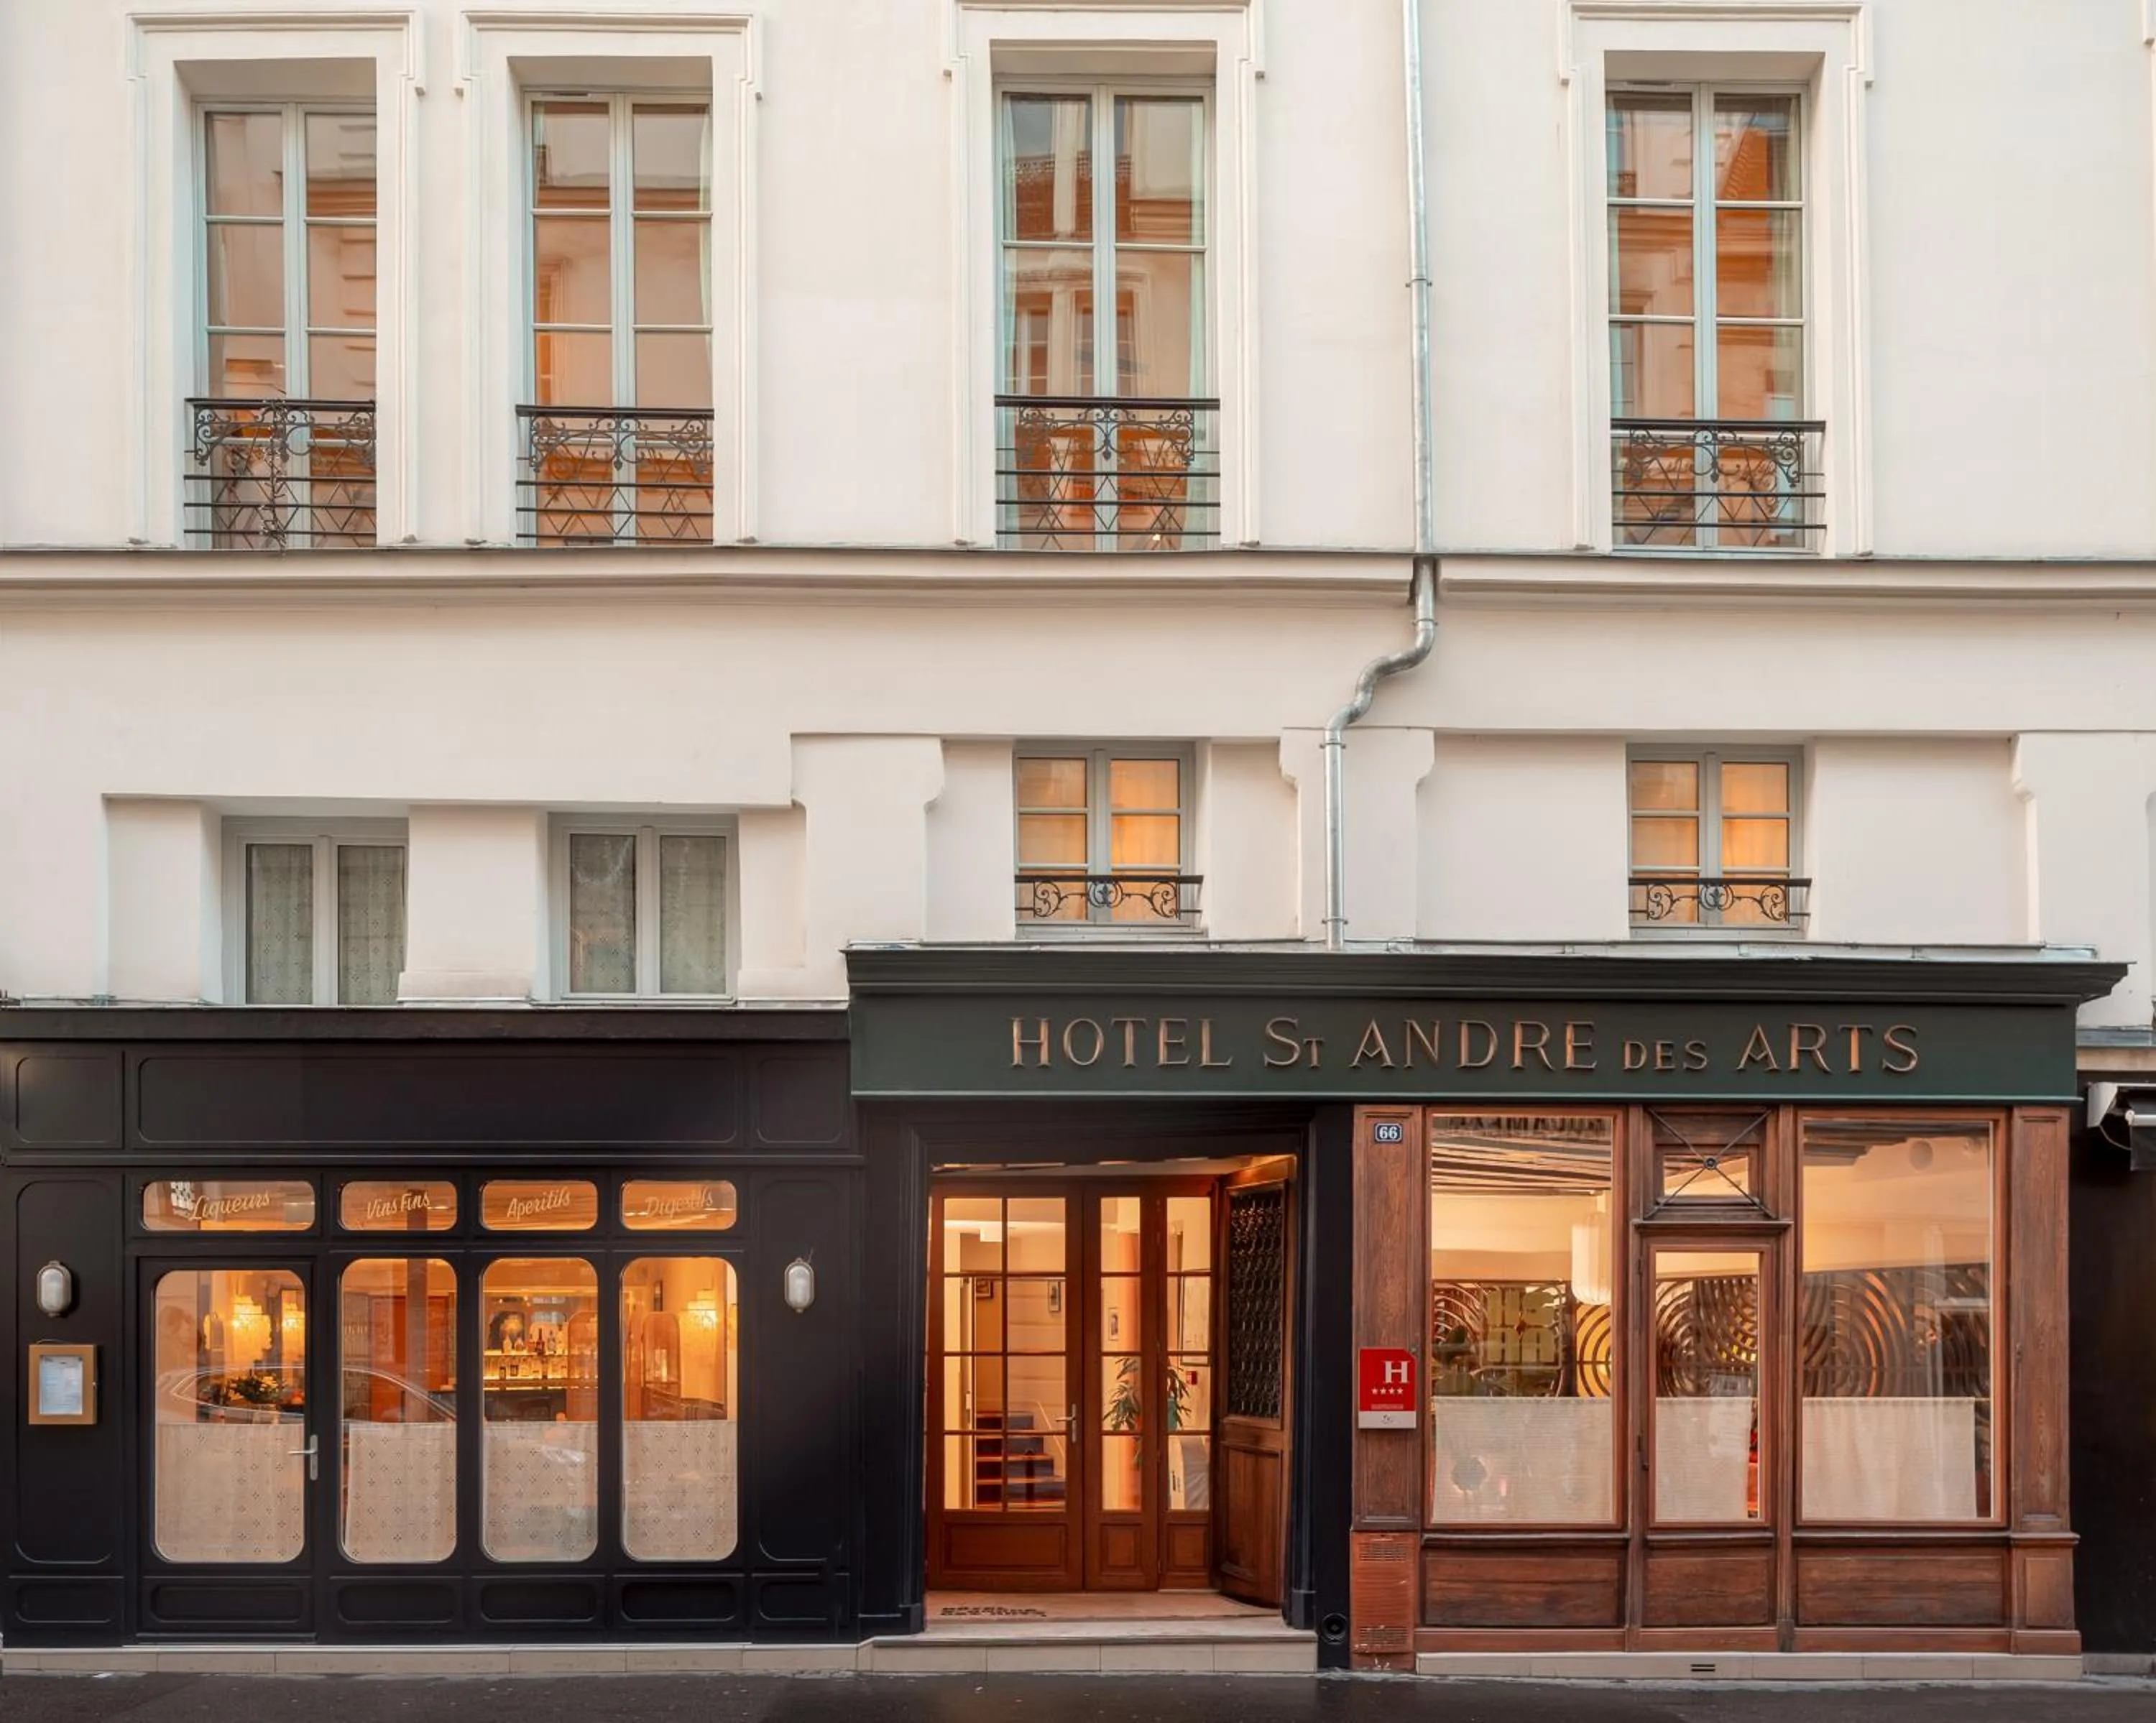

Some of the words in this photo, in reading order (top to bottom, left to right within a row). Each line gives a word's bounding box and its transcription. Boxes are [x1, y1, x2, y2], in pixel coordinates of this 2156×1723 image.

[1010, 1017, 1233, 1068] HOTEL
[1348, 1017, 1598, 1071] ANDRE
[1622, 1040, 1709, 1071] DES
[1736, 1023, 1920, 1073] ARTS
[1379, 1126, 1399, 1140] 66
[188, 1188, 270, 1221] Liqueurs
[367, 1198, 397, 1219] Vins
[400, 1191, 430, 1212] Fins
[506, 1186, 571, 1222] Aperitifs
[645, 1186, 714, 1219] Digestifs
[1383, 1360, 1410, 1384] H
